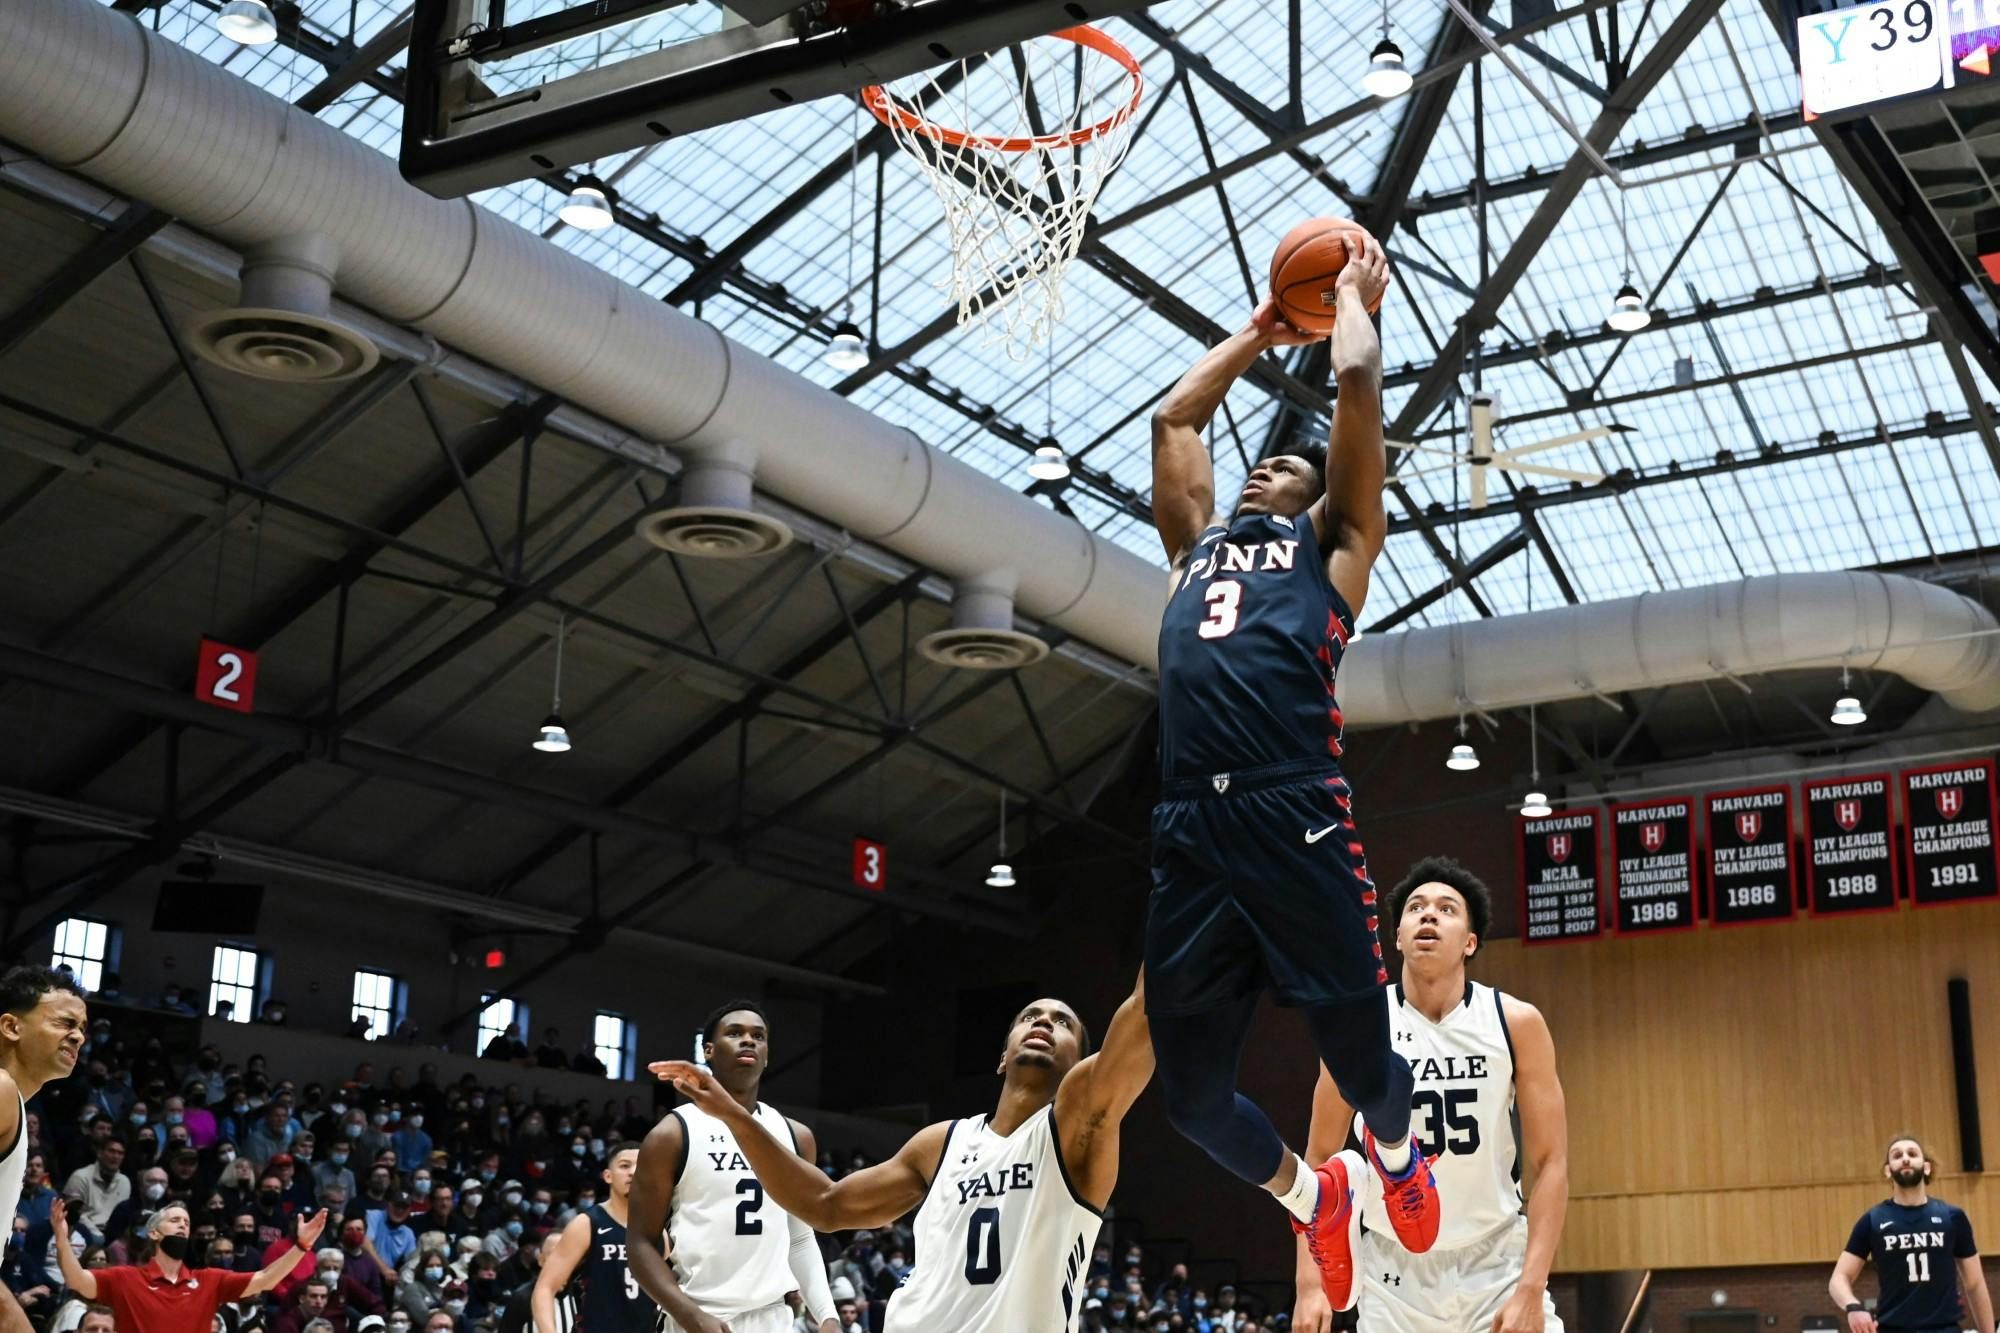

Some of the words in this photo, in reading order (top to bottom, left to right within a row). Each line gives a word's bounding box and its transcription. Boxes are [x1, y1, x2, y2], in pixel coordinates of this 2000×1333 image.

[1813, 16, 1858, 64] Y
[1869, 0, 1933, 51] 39
[1182, 540, 1299, 592] PENN
[1198, 580, 1243, 639] 3
[213, 653, 242, 702] 2
[1909, 768, 1986, 789] HARVARD
[1810, 781, 1884, 801] HARVARD
[1941, 790, 1956, 812] H
[1712, 792, 1783, 812] HARVARD
[1617, 804, 1687, 824] HARVARD
[1841, 803, 1855, 823] H
[1525, 815, 1592, 834] HARVARD
[1741, 814, 1755, 835] H
[1914, 826, 1936, 841] IVY
[1940, 819, 1988, 838] LEAGUE
[1645, 825, 1659, 846] H
[1814, 837, 1835, 851] IVY
[1839, 832, 1885, 849] LEAGUE
[1914, 833, 1991, 855] CHAMPIONS
[1552, 836, 1565, 856] H
[1715, 848, 1736, 862] IVY
[1739, 842, 1784, 859] LEAGUE
[1814, 845, 1888, 865] CHAMPIONS
[864, 847, 879, 882] 3
[1620, 859, 1640, 872] IVY
[1643, 853, 1687, 869] LEAGUE
[1715, 856, 1786, 875] CHAMPIONS
[1541, 865, 1579, 883] NCAA
[1620, 866, 1688, 885] TOURNAMENT
[1930, 863, 1979, 887] 1991
[1527, 878, 1595, 895] TOURNAMENT
[1620, 880, 1689, 899] CHAMPIONS
[1728, 884, 1775, 907] 1986
[1828, 874, 1877, 897] 1988
[1564, 893, 1594, 906] 1997
[1529, 910, 1559, 923] 1998
[1564, 906, 1595, 920] 2002
[1632, 901, 1678, 923] 1986
[1529, 924, 1559, 937] 2003
[1564, 920, 1595, 934] 2007
[1411, 1088, 1481, 1157] 35
[708, 1152, 752, 1171] YA
[735, 1178, 764, 1236] 2
[965, 1207, 1001, 1285] 0
[1883, 1232, 1945, 1251] PENN
[1906, 1252, 1930, 1283] 11
[624, 1267, 639, 1300] 5
